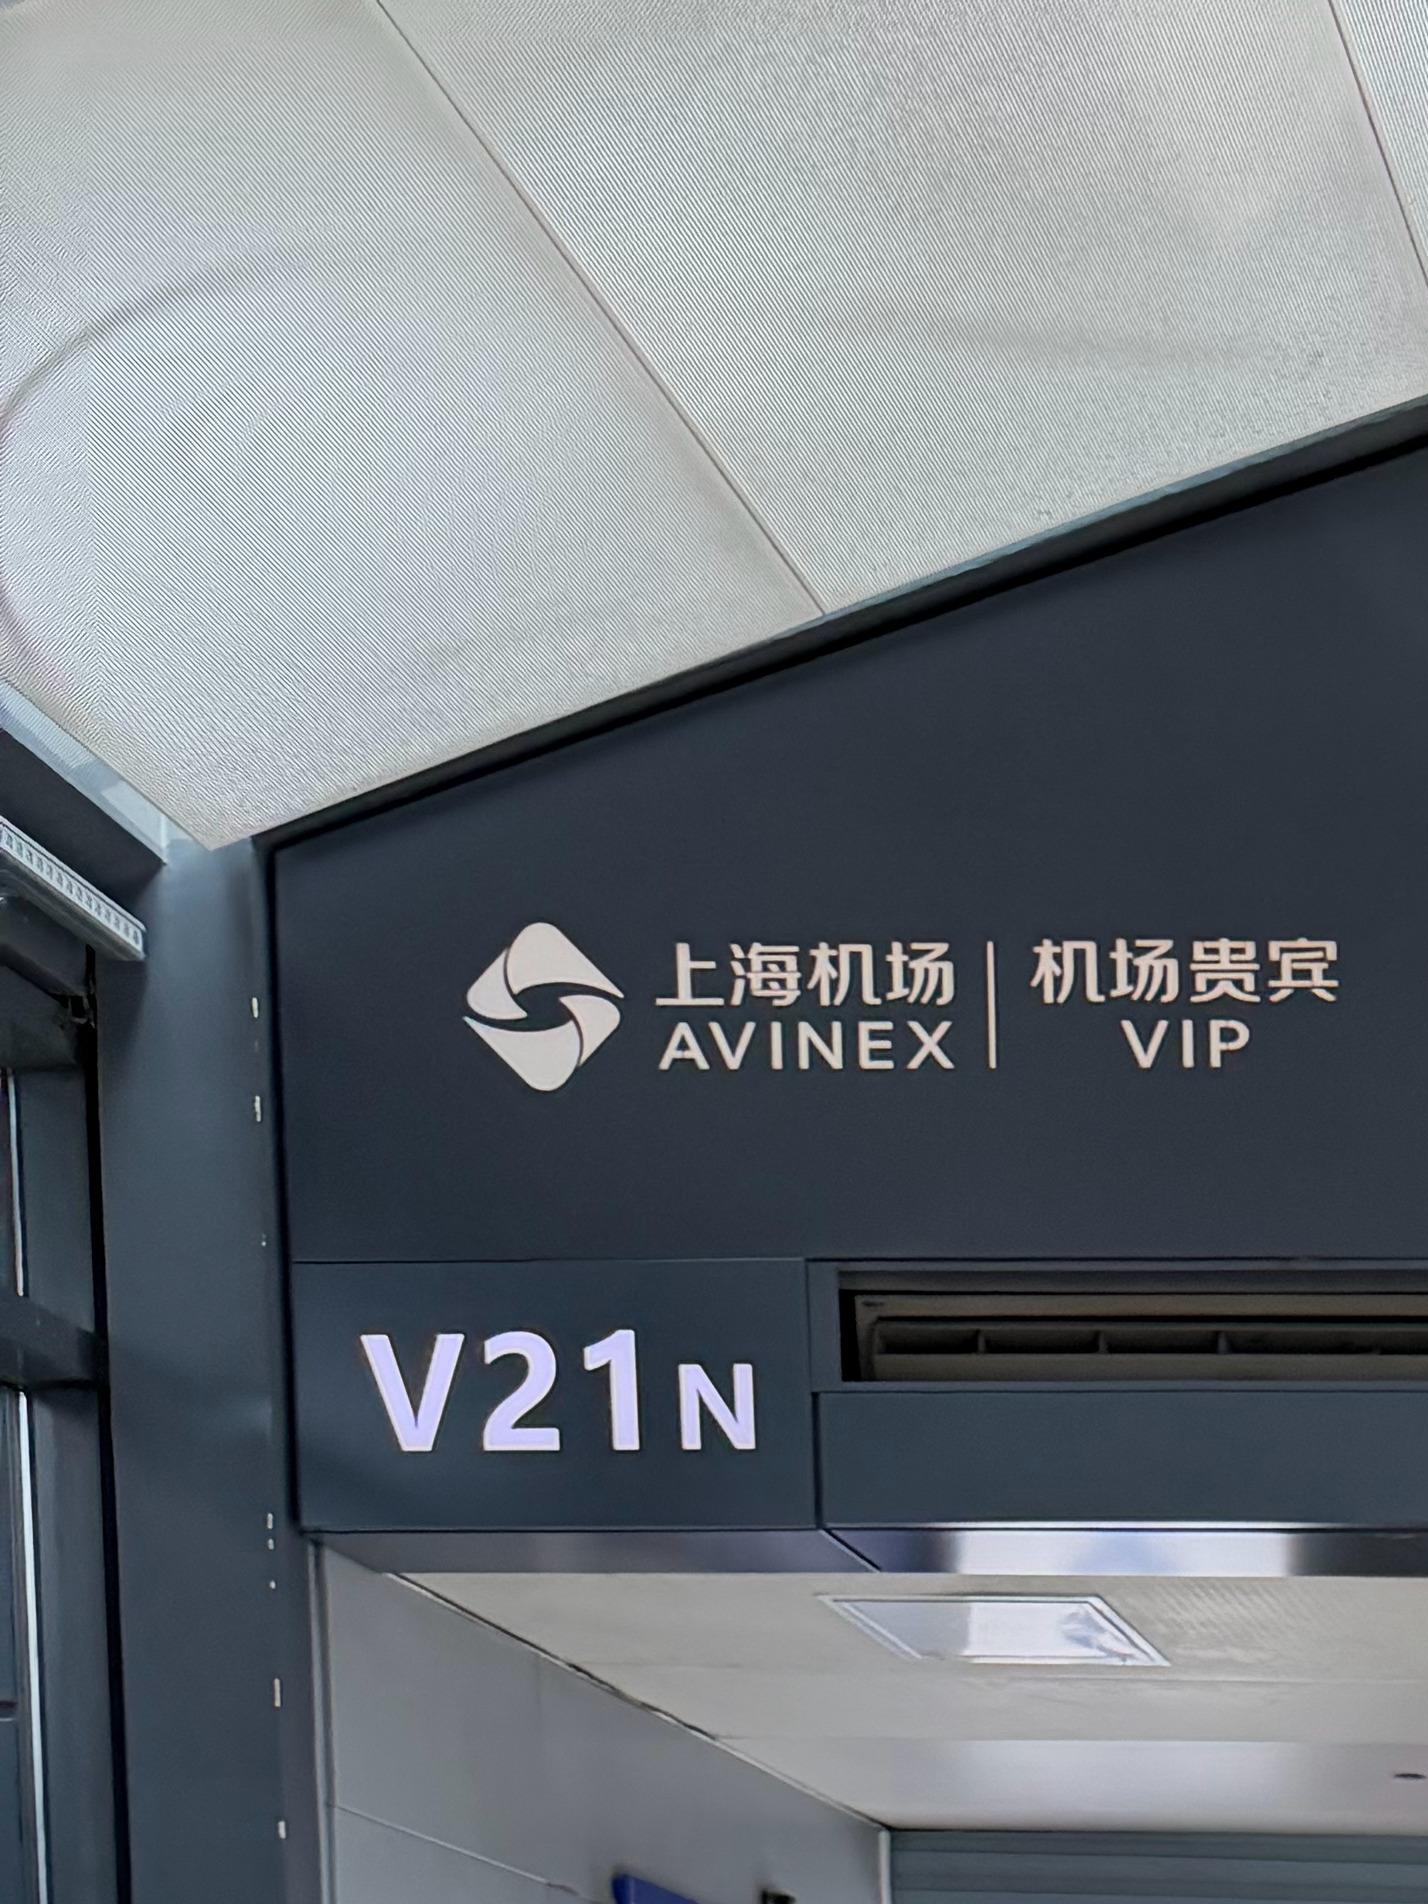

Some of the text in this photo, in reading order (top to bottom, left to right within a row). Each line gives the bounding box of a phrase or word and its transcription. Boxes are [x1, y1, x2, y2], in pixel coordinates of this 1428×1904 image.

[655, 940, 956, 1008] 上海机场
[1029, 936, 1340, 1005] 机场贵宾
[657, 1020, 956, 1071] AVINEX
[1119, 1018, 1251, 1070] VIP
